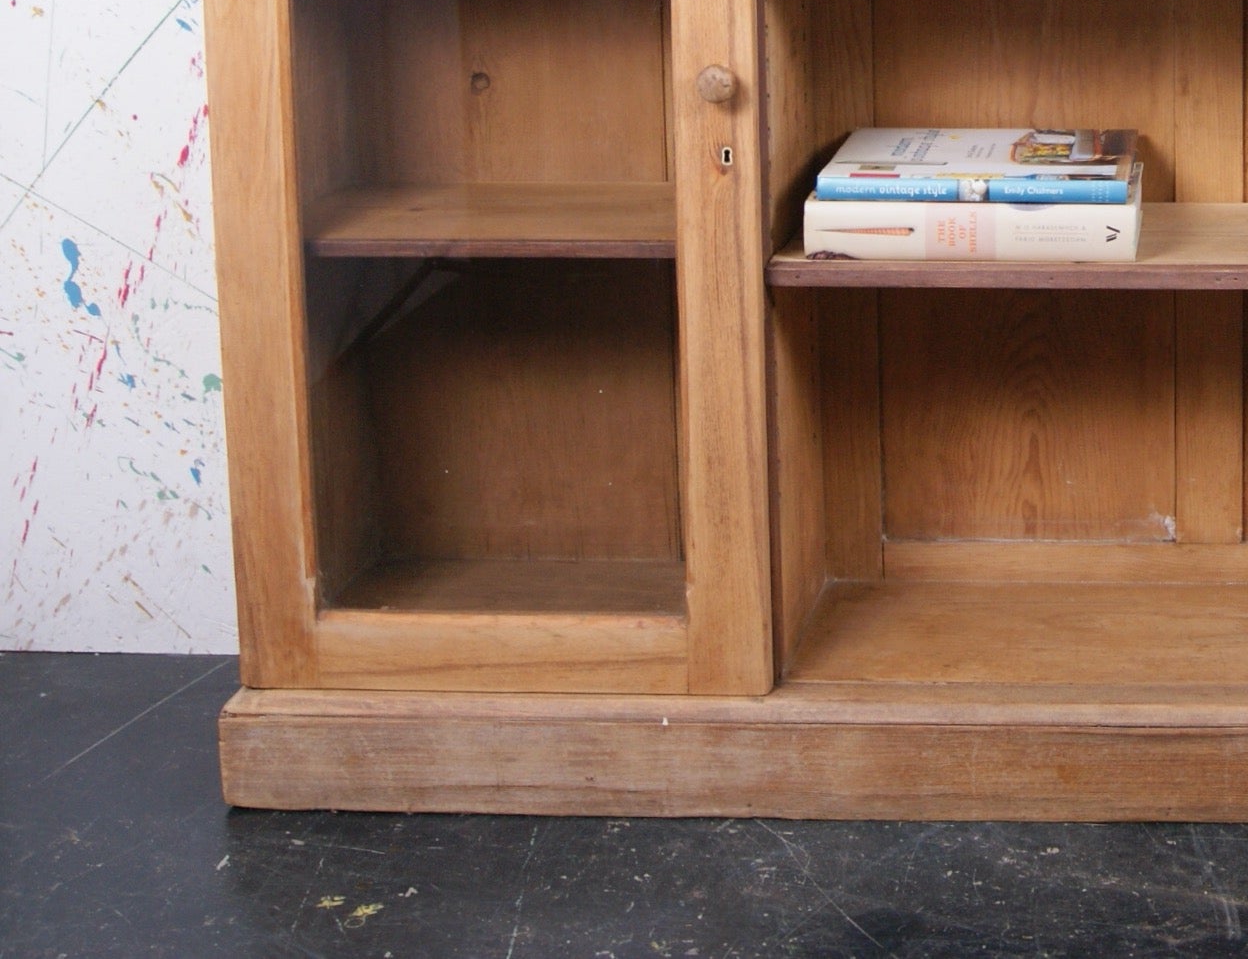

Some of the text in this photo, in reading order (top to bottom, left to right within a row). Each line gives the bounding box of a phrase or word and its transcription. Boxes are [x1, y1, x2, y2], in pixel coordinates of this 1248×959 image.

[835, 184, 947, 197] modern vintage style
[1026, 185, 1064, 196] Chalmers
[937, 221, 946, 243] THE
[947, 217, 956, 247] BOOK
[959, 225, 966, 240] OF
[969, 211, 977, 253] SHELLS
